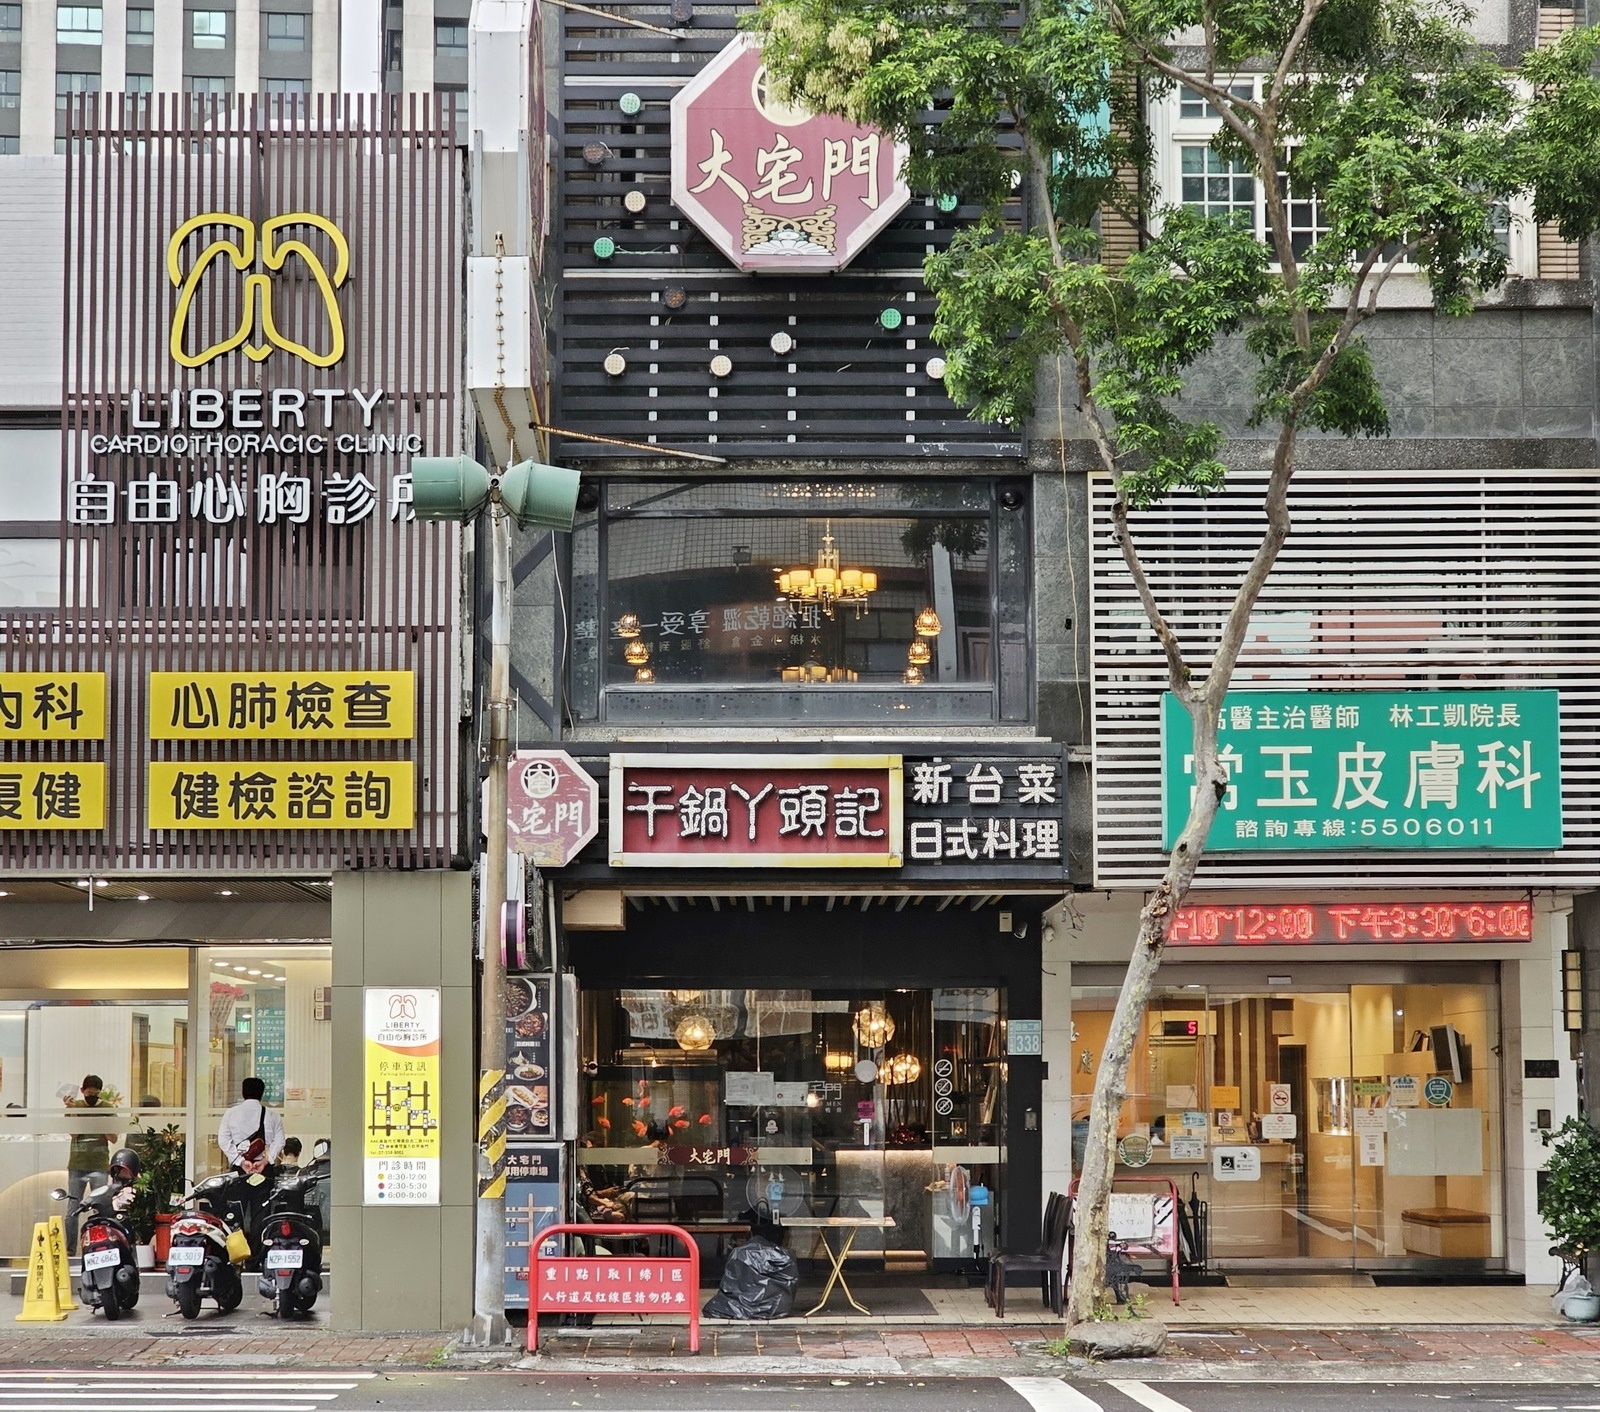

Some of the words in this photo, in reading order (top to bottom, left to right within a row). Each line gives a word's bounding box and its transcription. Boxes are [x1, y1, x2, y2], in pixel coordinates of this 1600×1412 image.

[689, 128, 881, 210] 大宅門
[131, 388, 384, 428] LIBERTY
[90, 434, 324, 455] CARDIOTHORACIC
[337, 433, 423, 455] CLINIC
[171, 680, 392, 730] 心肺檢查
[1389, 703, 1521, 728] 林工凱院長
[913, 762, 1056, 805] 新台菜
[170, 771, 392, 820] 健檢諮詢
[627, 782, 886, 840] 干鍋丫頭記
[911, 819, 1060, 860] 日式料理
[1235, 818, 1493, 838] 諮詢專線:5506011
[1016, 1034, 1040, 1053] 338
[380, 1061, 427, 1072] 停車資訊
[379, 1160, 426, 1171] 門診時間
[507, 1155, 542, 1165] 大宅門
[689, 1147, 731, 1166] 大宅門
[542, 1291, 686, 1304] 人行道及紅線區請勿停車
